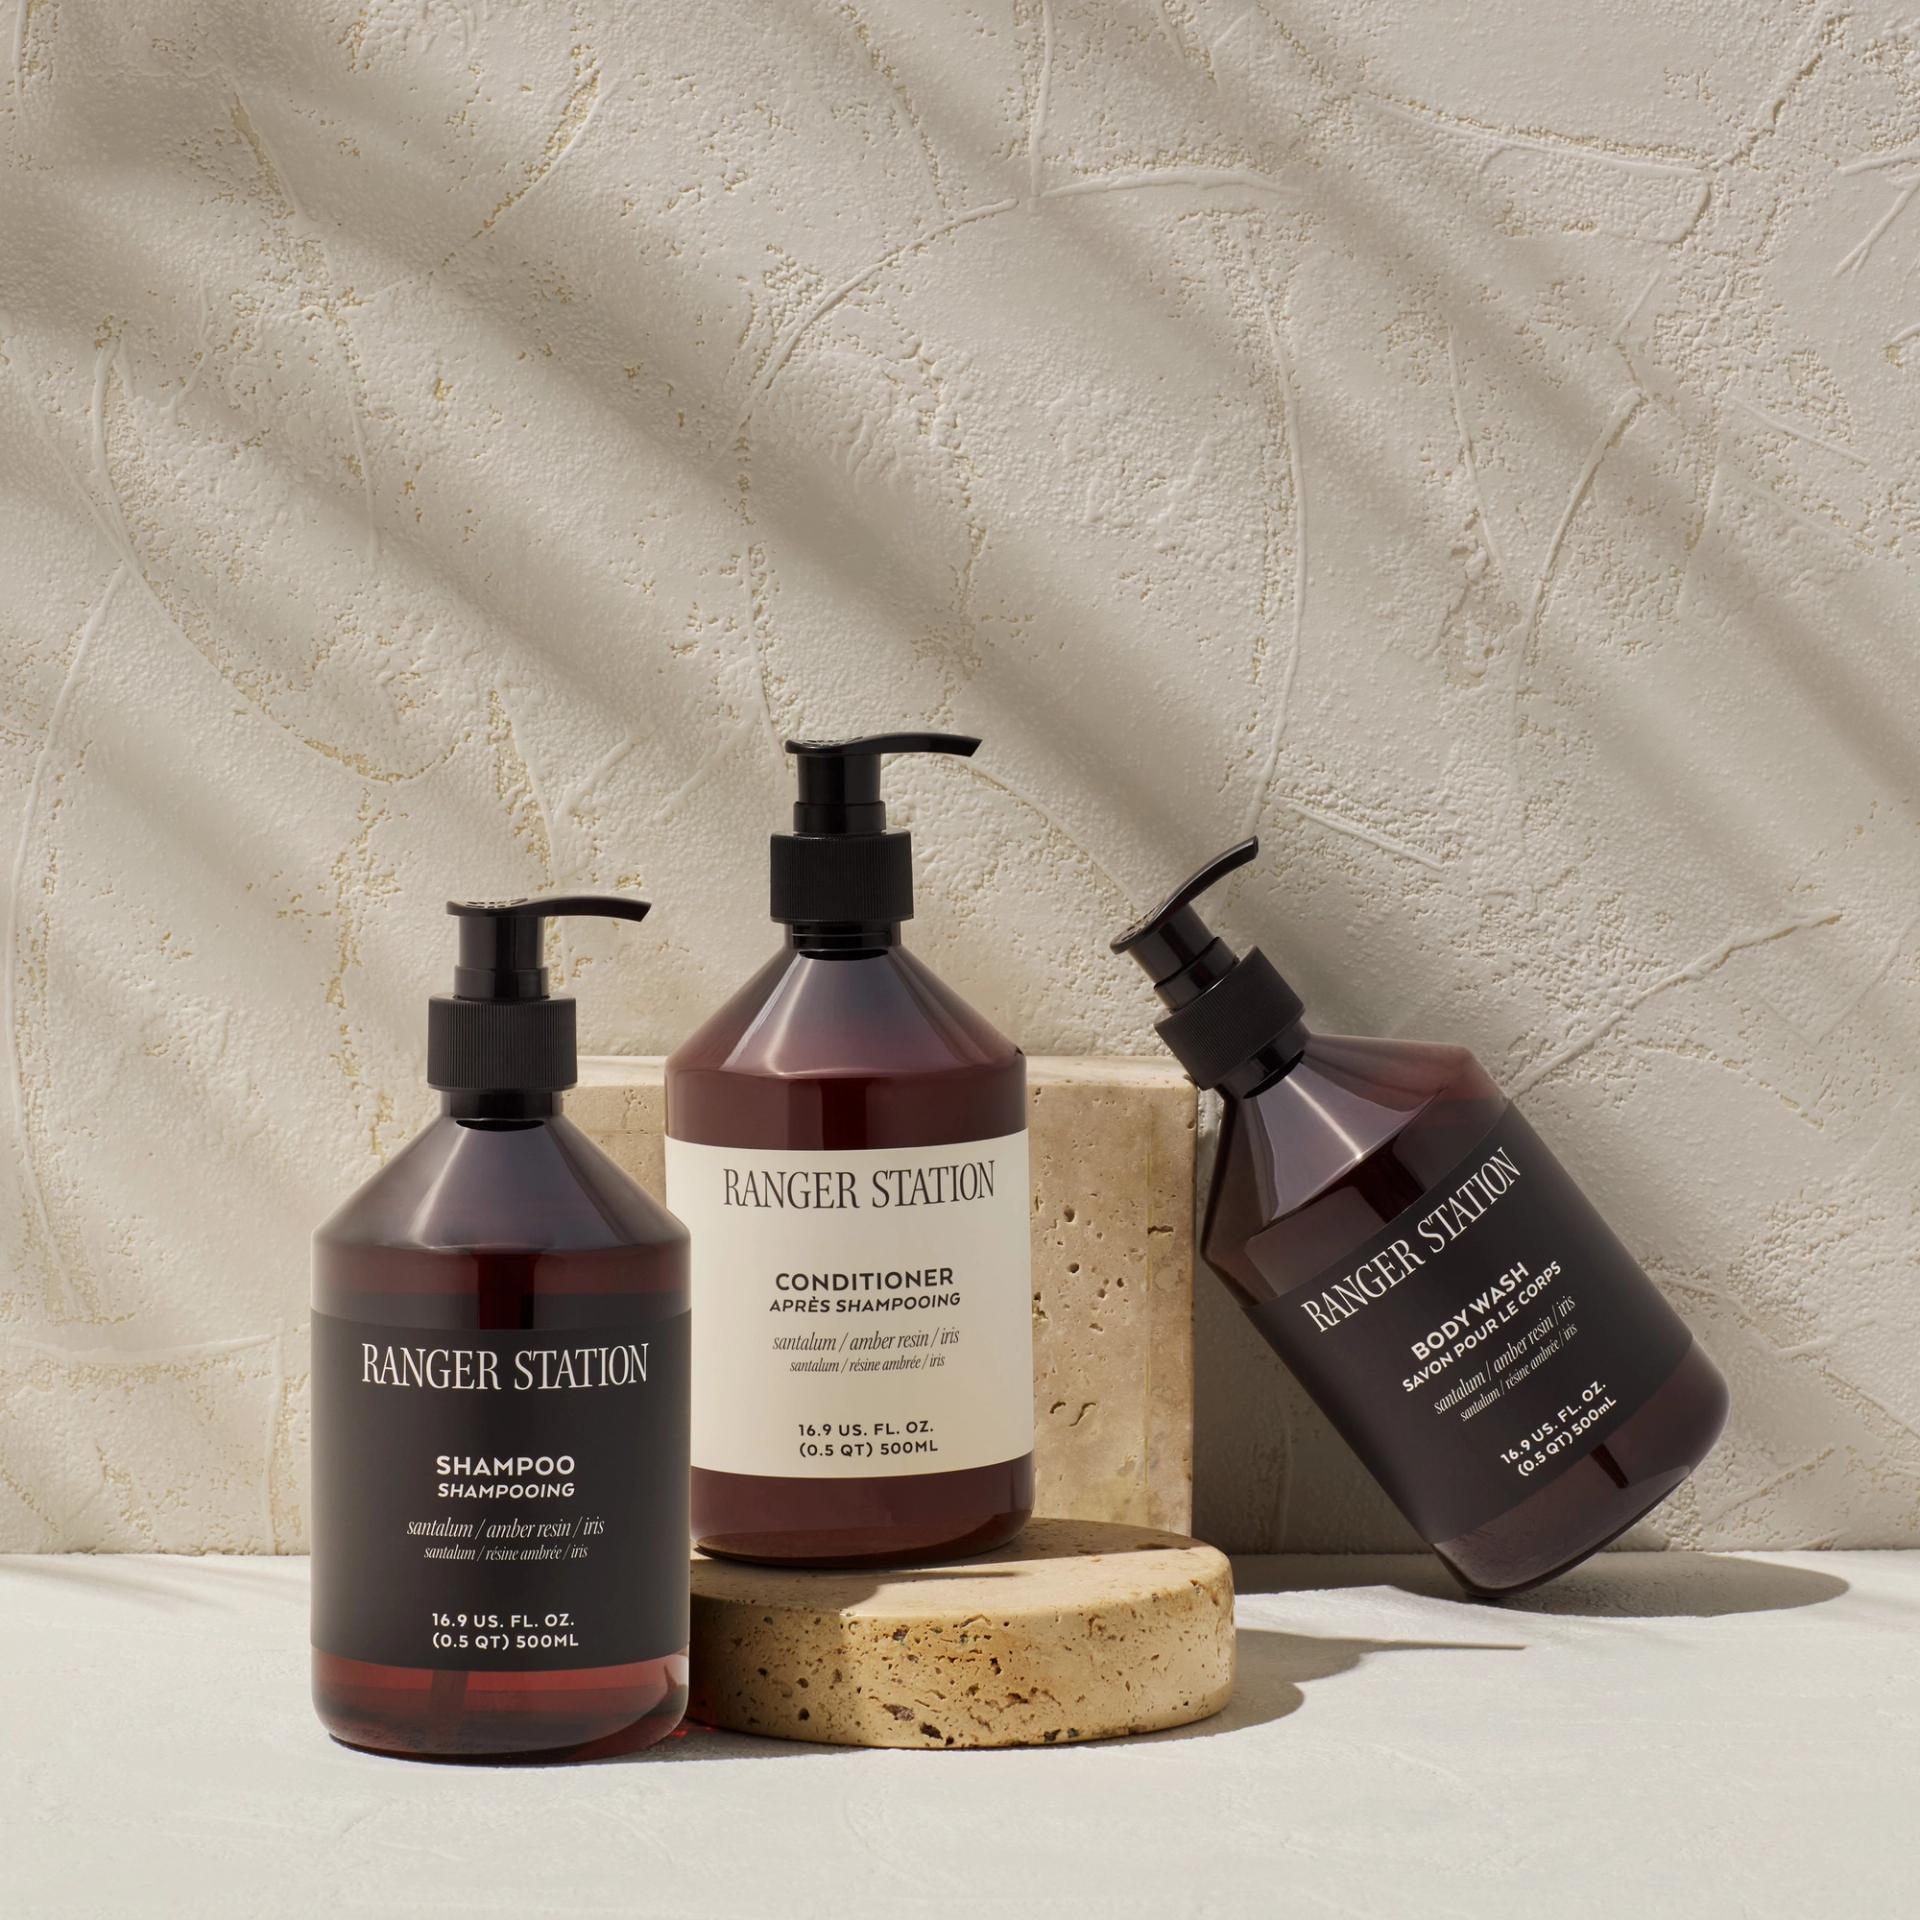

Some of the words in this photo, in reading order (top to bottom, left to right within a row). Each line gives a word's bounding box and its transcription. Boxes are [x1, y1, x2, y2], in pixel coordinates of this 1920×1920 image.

[723, 1168, 860, 1209] RANGER
[872, 1160, 995, 1208] STATION
[1300, 1239, 1426, 1333] RANGER
[1417, 1147, 1521, 1253] STATION
[775, 1267, 953, 1291] CONDITIONER
[769, 1296, 830, 1313] APRÈS
[836, 1292, 960, 1313] SHAMPOOING
[1411, 1309, 1471, 1361] BODY
[1469, 1261, 1529, 1315] WASH
[772, 1331, 836, 1351] santalum
[850, 1330, 895, 1350] amber
[897, 1330, 928, 1348] resin
[940, 1326, 960, 1345] iris
[1402, 1352, 1453, 1393] SAVON
[1453, 1318, 1499, 1357] POUR
[1498, 1304, 1519, 1323] LE
[1518, 1260, 1561, 1312] CORPS
[362, 1343, 502, 1390] RANGER
[514, 1343, 649, 1390] STATION
[790, 1357, 840, 1373] santalum
[849, 1358, 880, 1372] résine
[882, 1355, 921, 1370] ambrée
[929, 1353, 946, 1368] iris
[1434, 1371, 1486, 1414] santalum
[1493, 1337, 1528, 1373] amber
[1528, 1316, 1554, 1345] resin
[1557, 1295, 1576, 1317] iris
[1460, 1388, 1500, 1422] santalum
[1505, 1365, 1531, 1389] résine
[1531, 1338, 1560, 1370] ambrée
[1562, 1323, 1578, 1341] iris
[798, 1424, 832, 1437] 16.9
[839, 1424, 867, 1436] US.
[874, 1424, 899, 1435] FL.
[906, 1421, 934, 1433] OZ.
[1500, 1440, 1530, 1464] 16.9
[1531, 1422, 1558, 1442] US.
[1557, 1405, 1582, 1423] FL.
[1582, 1381, 1606, 1402] OZ.
[1518, 1451, 1546, 1476] (0.5
[1546, 1431, 1573, 1455] QT)
[1571, 1396, 1617, 1435] 500mL
[800, 1444, 834, 1457] (0.5
[841, 1443, 873, 1457] QT)
[880, 1440, 938, 1455] 500ML
[436, 1455, 575, 1476] SHAMPOO
[438, 1482, 575, 1499] SHAMPOOING
[407, 1517, 474, 1538] santalum
[486, 1518, 536, 1539] amber
[537, 1518, 571, 1538] resin
[583, 1516, 605, 1535] iris
[423, 1544, 476, 1560] santalum
[485, 1546, 519, 1561] résine
[520, 1544, 562, 1560] ambrée
[571, 1544, 589, 1558] iris
[432, 1612, 467, 1628] 16.9
[473, 1615, 503, 1628] US.
[511, 1615, 538, 1628] FL.
[545, 1614, 574, 1627] OZ.
[433, 1634, 468, 1648] (0.5
[475, 1635, 509, 1650] QT)
[516, 1634, 578, 1648] 500ML
